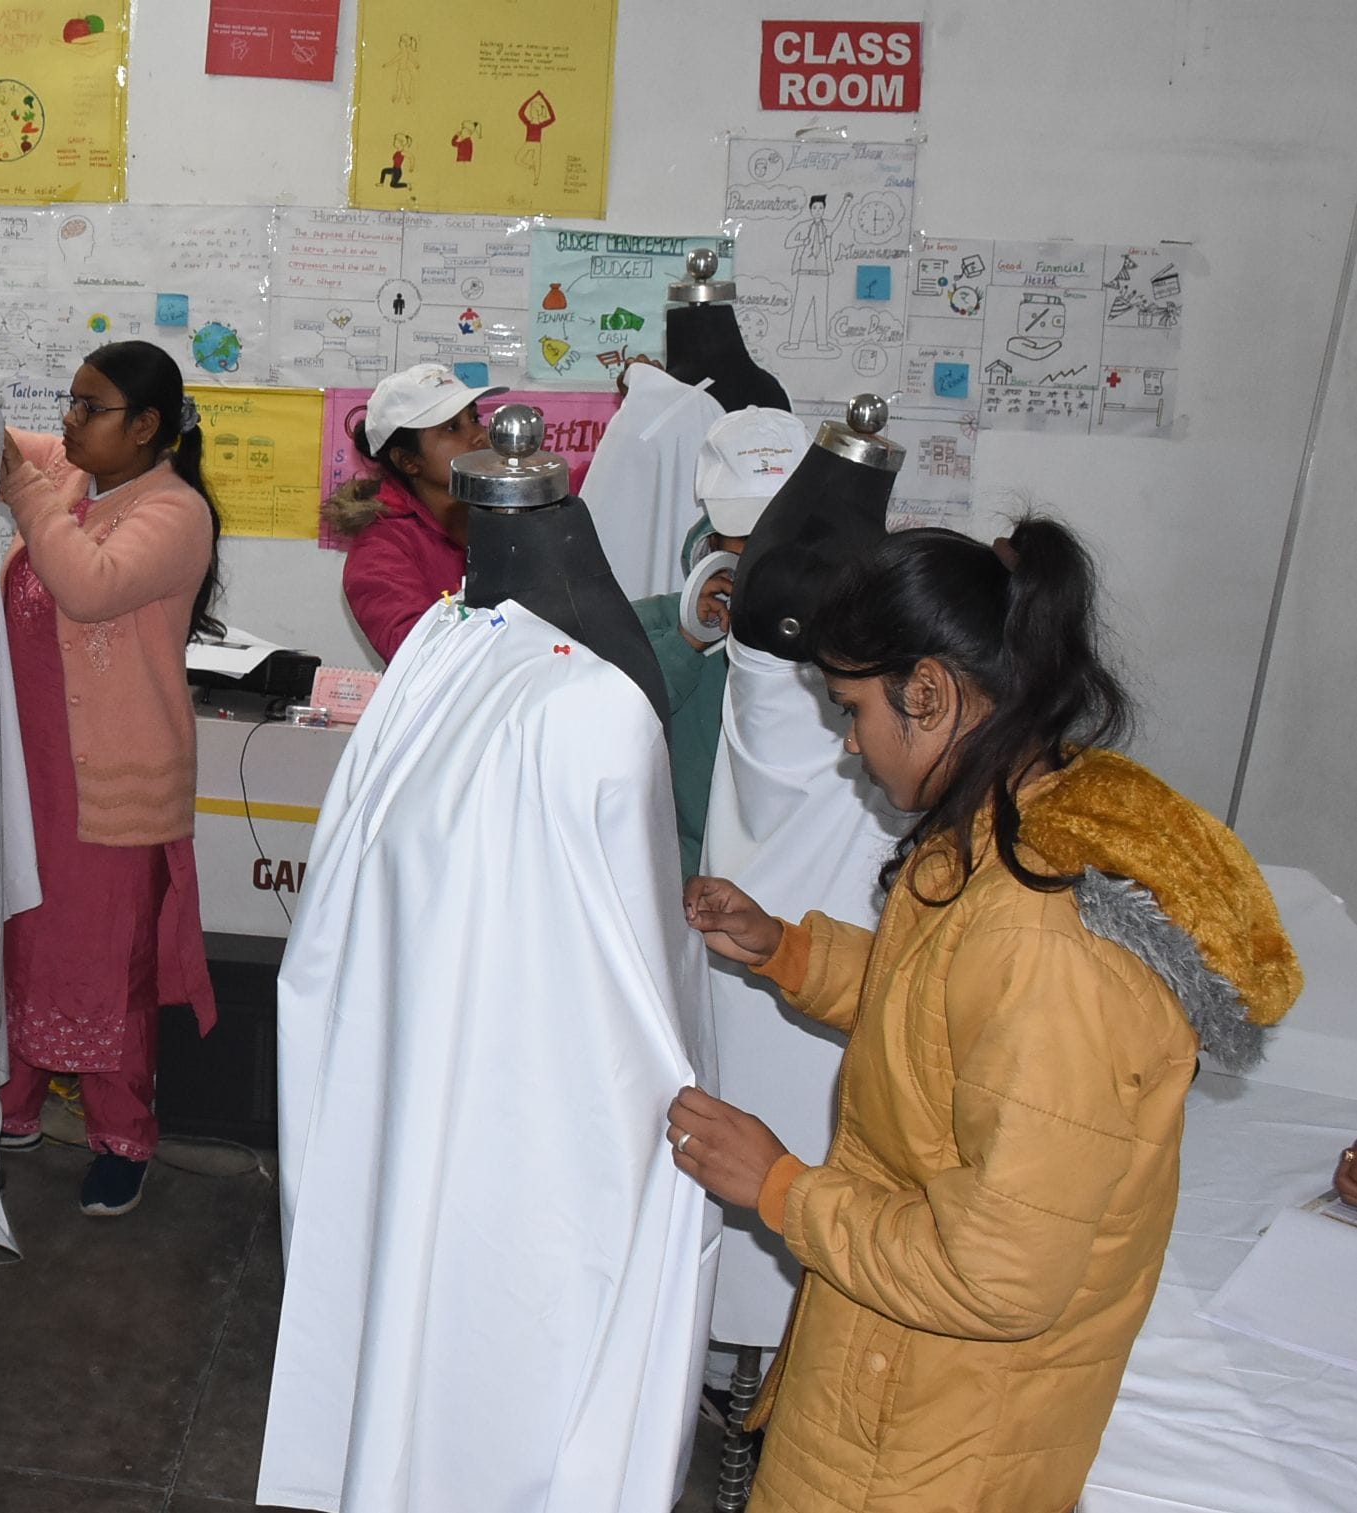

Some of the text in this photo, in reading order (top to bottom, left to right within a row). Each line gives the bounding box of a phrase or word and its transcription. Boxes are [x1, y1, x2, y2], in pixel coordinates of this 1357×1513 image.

[774, 31, 912, 66] CLASS
[779, 73, 905, 107] ROOM
[597, 332, 628, 344] CASH
[553, 350, 581, 376] FUND
[7, 382, 61, 402] Tailoring
